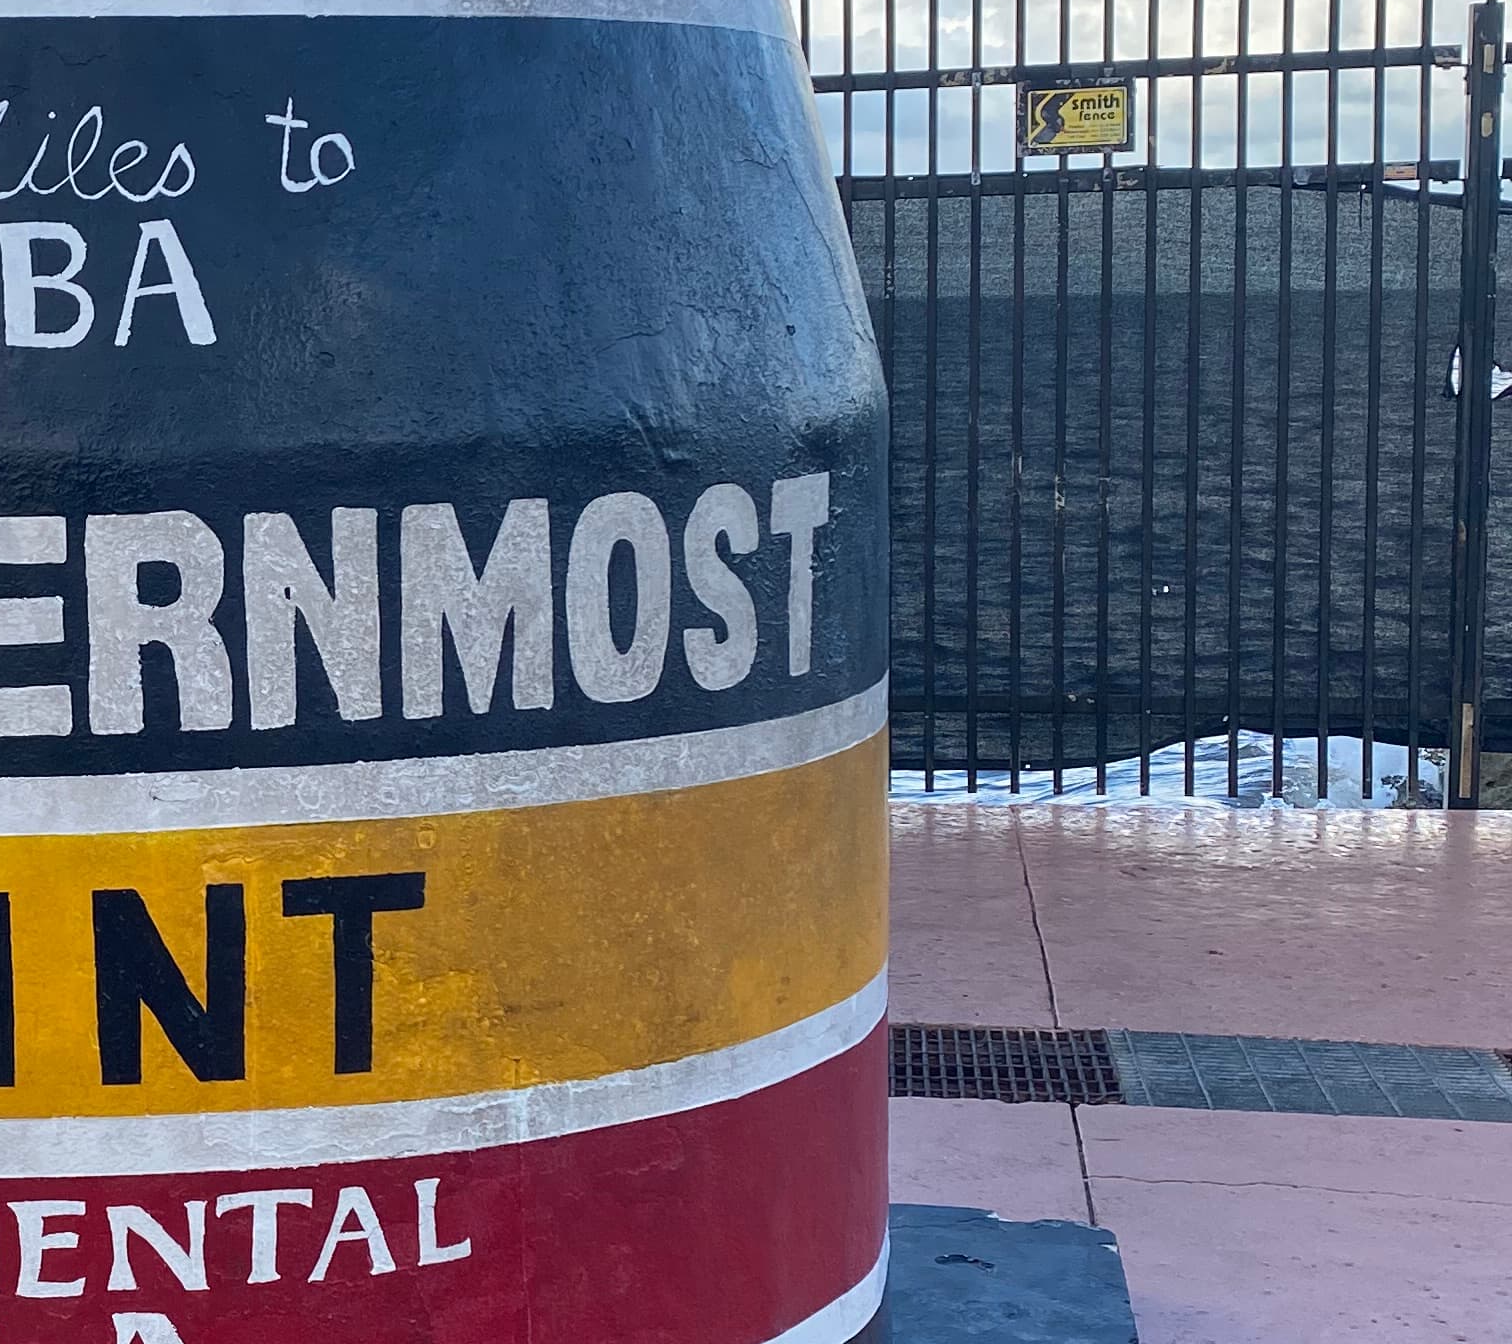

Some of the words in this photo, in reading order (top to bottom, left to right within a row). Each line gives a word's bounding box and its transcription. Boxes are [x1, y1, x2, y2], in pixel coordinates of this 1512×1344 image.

[1072, 94, 1120, 110] smith
[1079, 111, 1115, 122] fence
[265, 96, 356, 193] to
